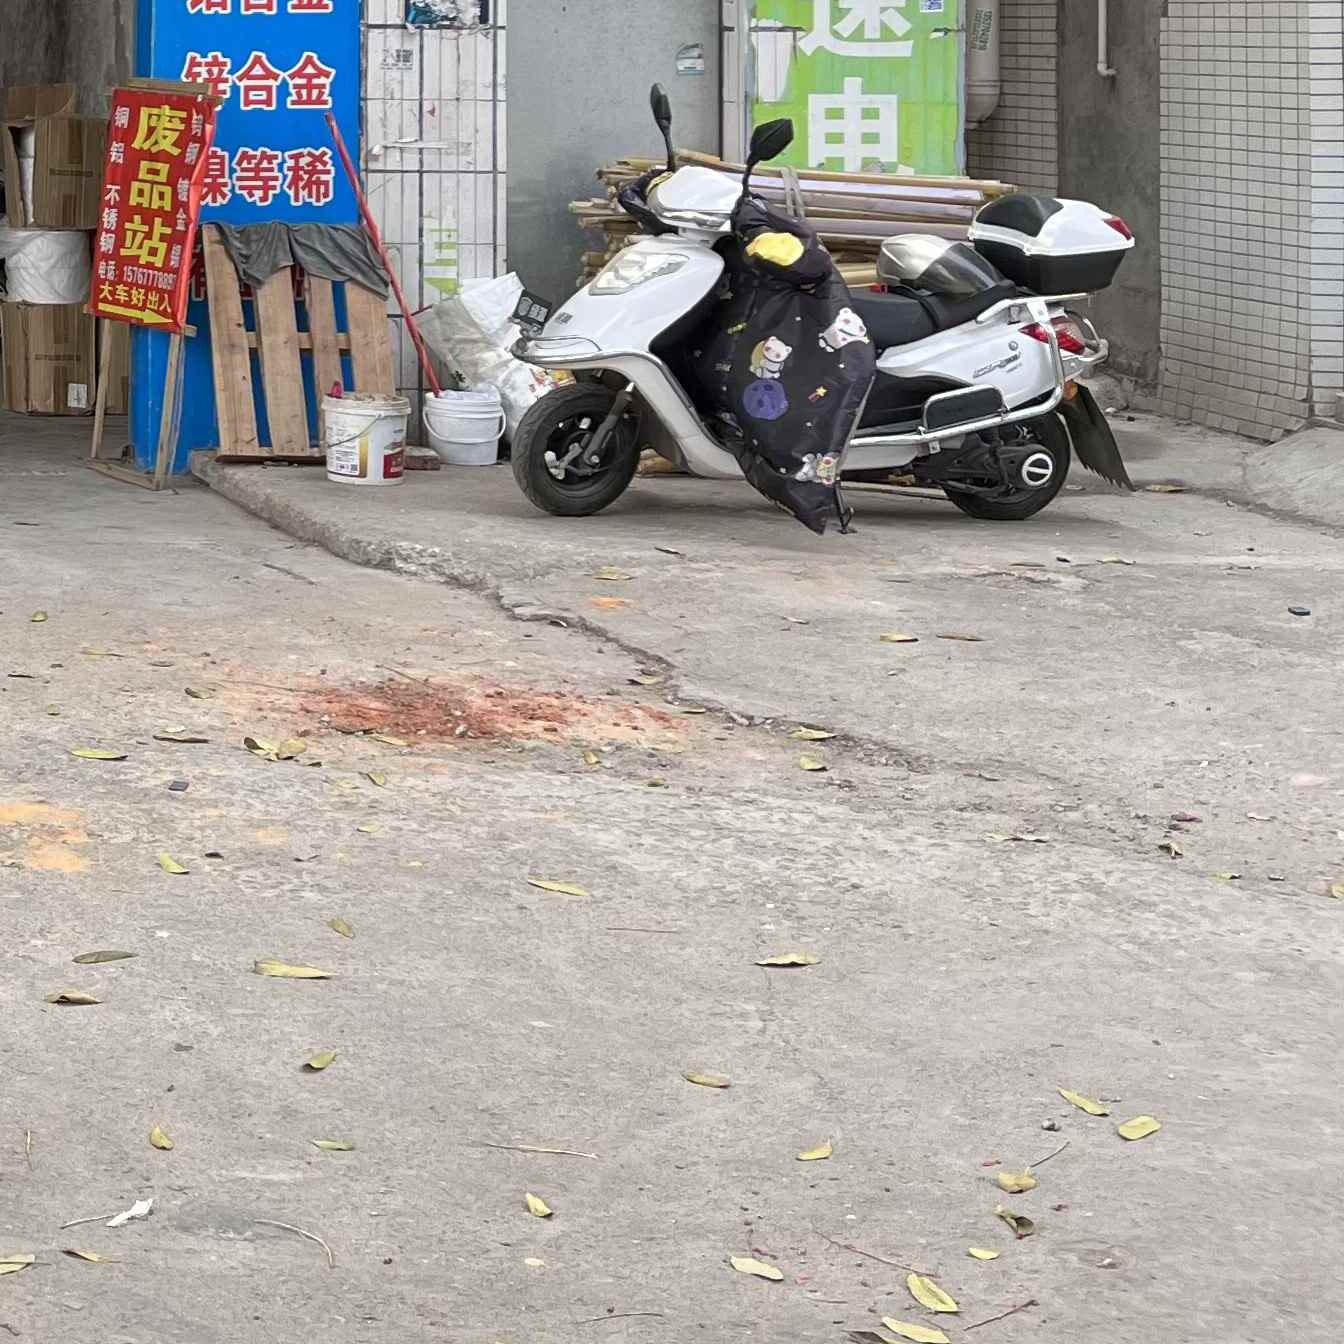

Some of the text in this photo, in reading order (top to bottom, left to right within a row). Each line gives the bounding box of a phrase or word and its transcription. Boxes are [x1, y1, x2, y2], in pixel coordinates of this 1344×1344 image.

[99, 184, 121, 255] 不锈钢
[120, 105, 188, 268] 废品站
[99, 281, 172, 313] 大车好出入
